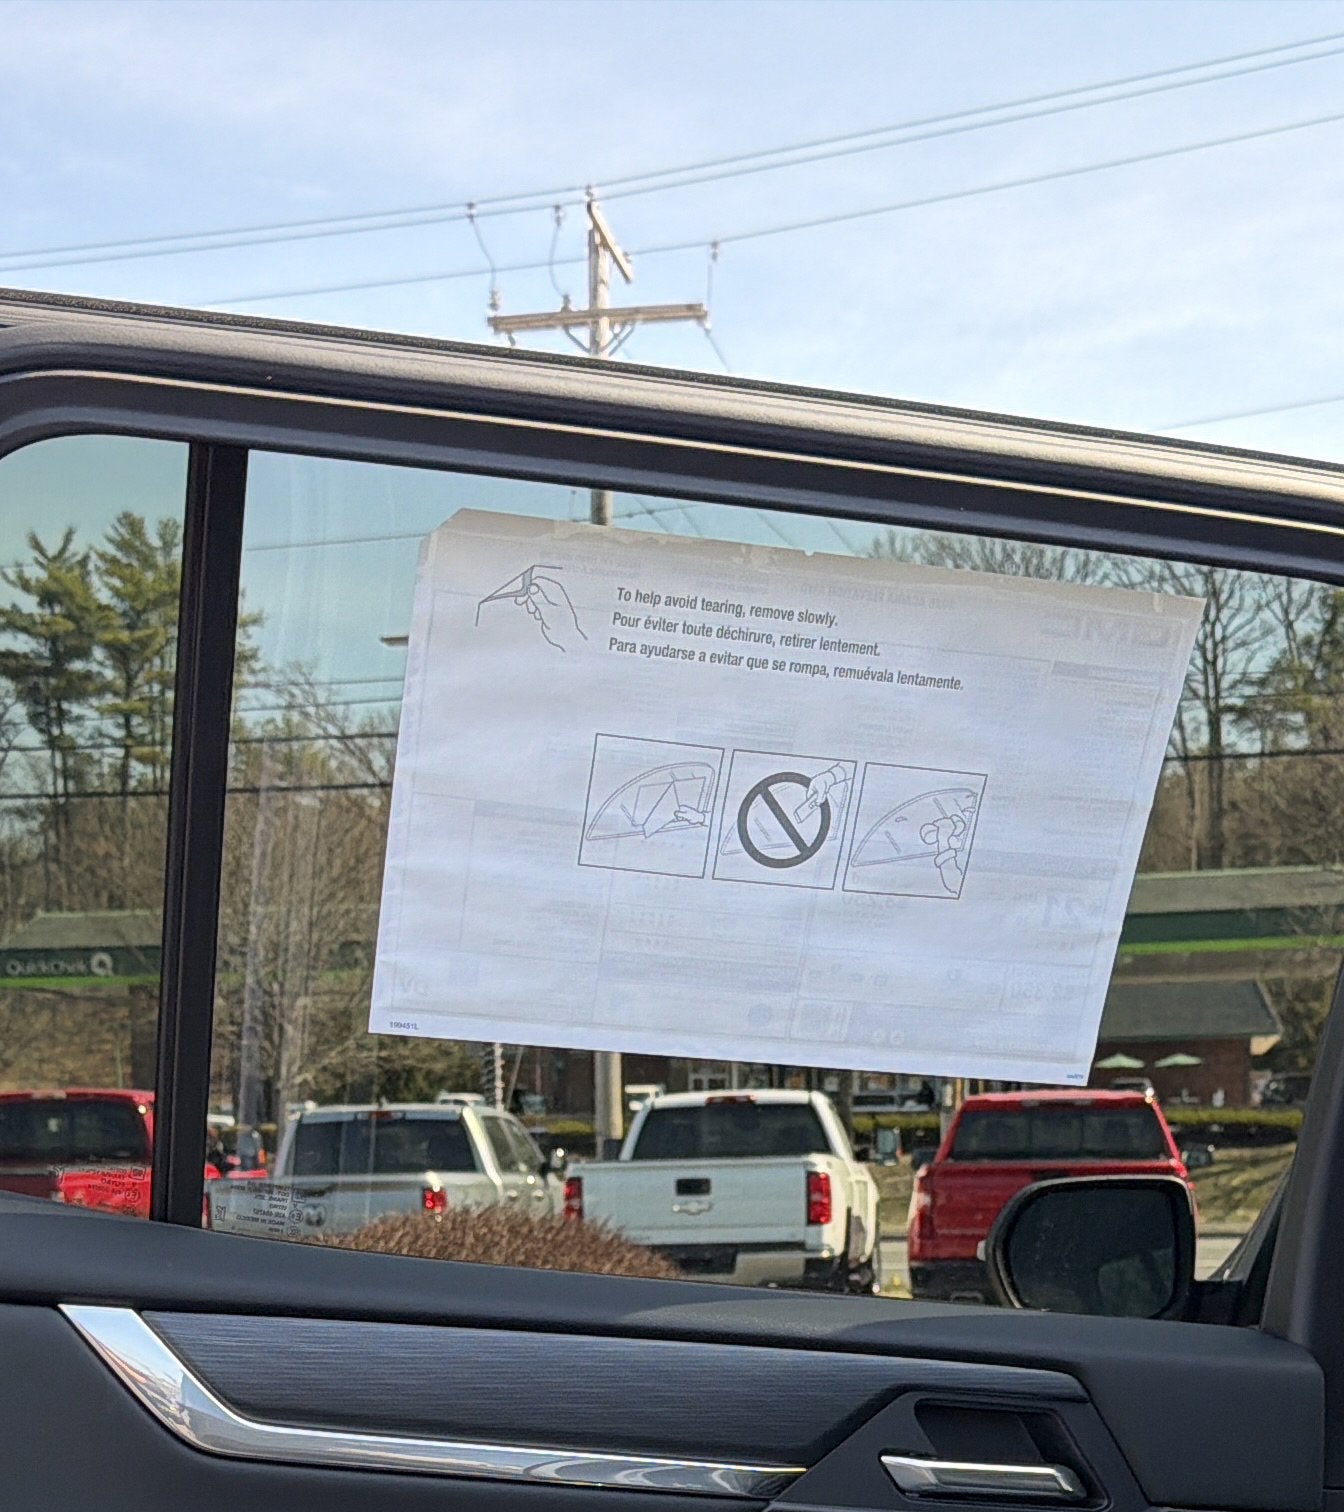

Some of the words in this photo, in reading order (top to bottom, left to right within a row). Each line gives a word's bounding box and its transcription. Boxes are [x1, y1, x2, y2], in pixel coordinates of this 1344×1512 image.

[617, 587, 631, 601] To
[634, 589, 661, 607] help
[665, 595, 697, 609] avoid
[701, 598, 745, 617] tearing,
[749, 605, 795, 621] remove
[797, 609, 838, 628] slowly.
[612, 612, 641, 627] Pour
[644, 615, 679, 632] éviter
[682, 621, 713, 637] toute
[716, 626, 776, 647] déchirure,
[780, 634, 817, 649] retirer
[819, 637, 880, 656] lentement.
[609, 637, 637, 653] Para
[640, 643, 696, 661] ayudarse
[698, 651, 706, 662] a
[710, 652, 744, 666] evitar
[746, 656, 769, 670] que
[772, 660, 786, 672] se
[789, 662, 830, 678] rompa,
[833, 666, 894, 683] remuévala
[897, 671, 964, 690] lentamente.
